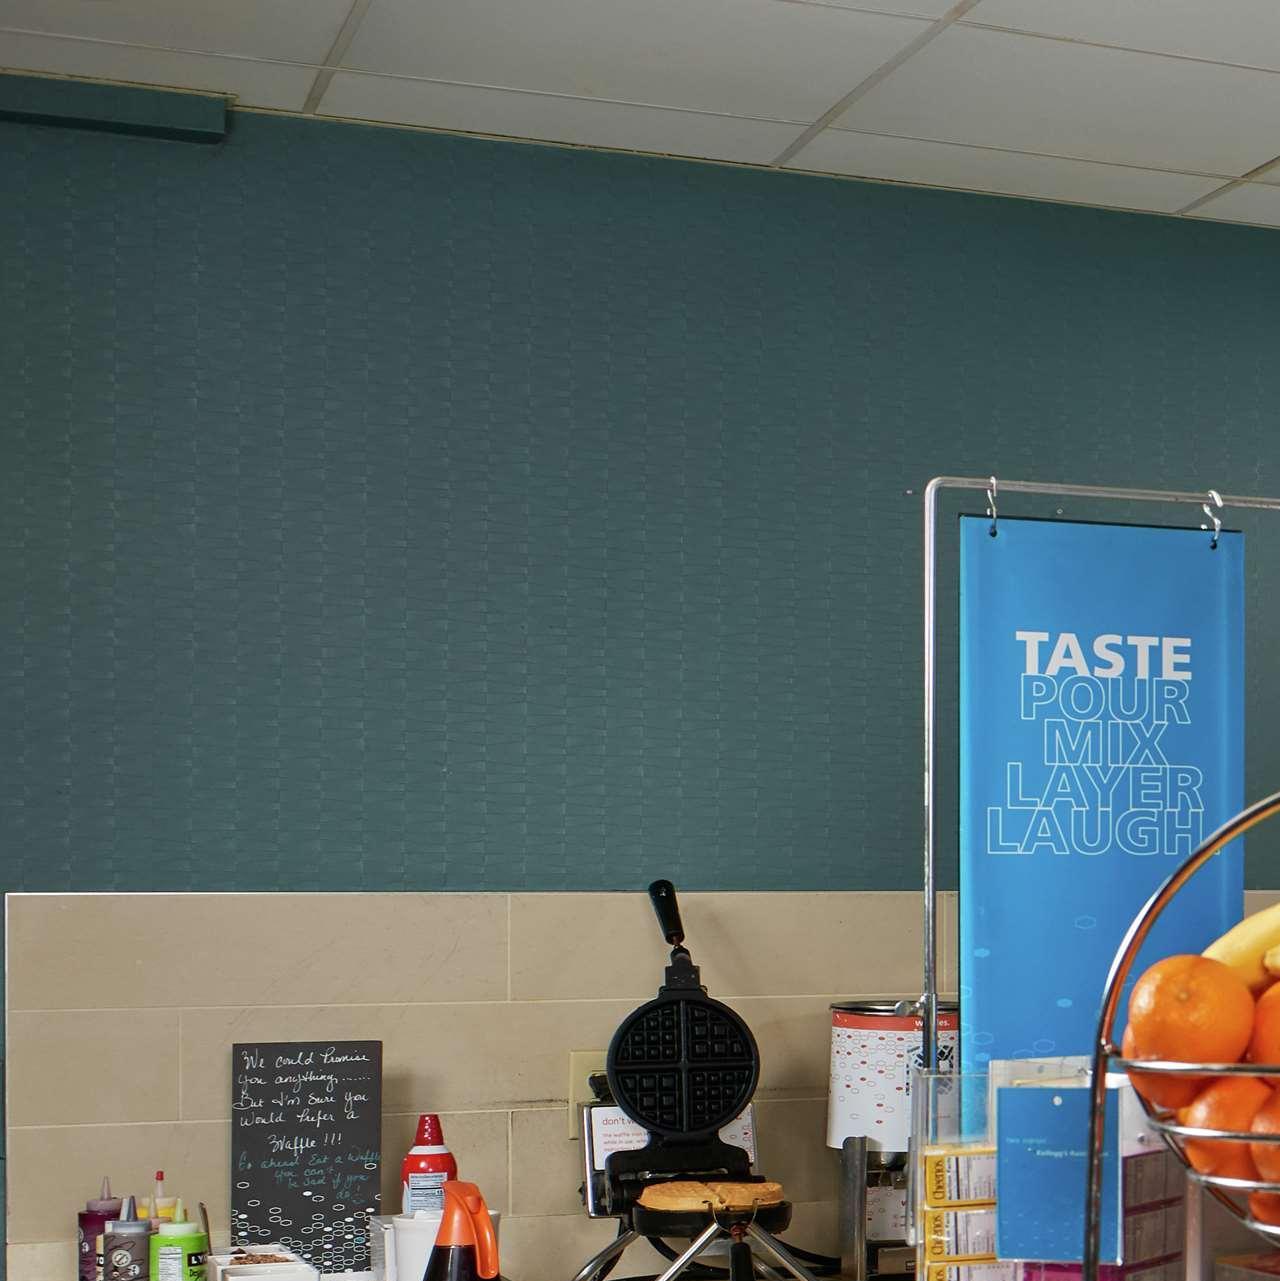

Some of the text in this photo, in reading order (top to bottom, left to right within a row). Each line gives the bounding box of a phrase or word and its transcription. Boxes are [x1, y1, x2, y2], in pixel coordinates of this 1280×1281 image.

[1015, 630, 1193, 681] TASTE
[1020, 672, 1192, 725] POUR
[1044, 718, 1170, 767] MIX
[1007, 762, 1205, 812] LAYER
[241, 1048, 265, 1070] We
[274, 1051, 314, 1069] could
[602, 1116, 625, 1126] don't
[932, 1159, 945, 1201] Cheerios
